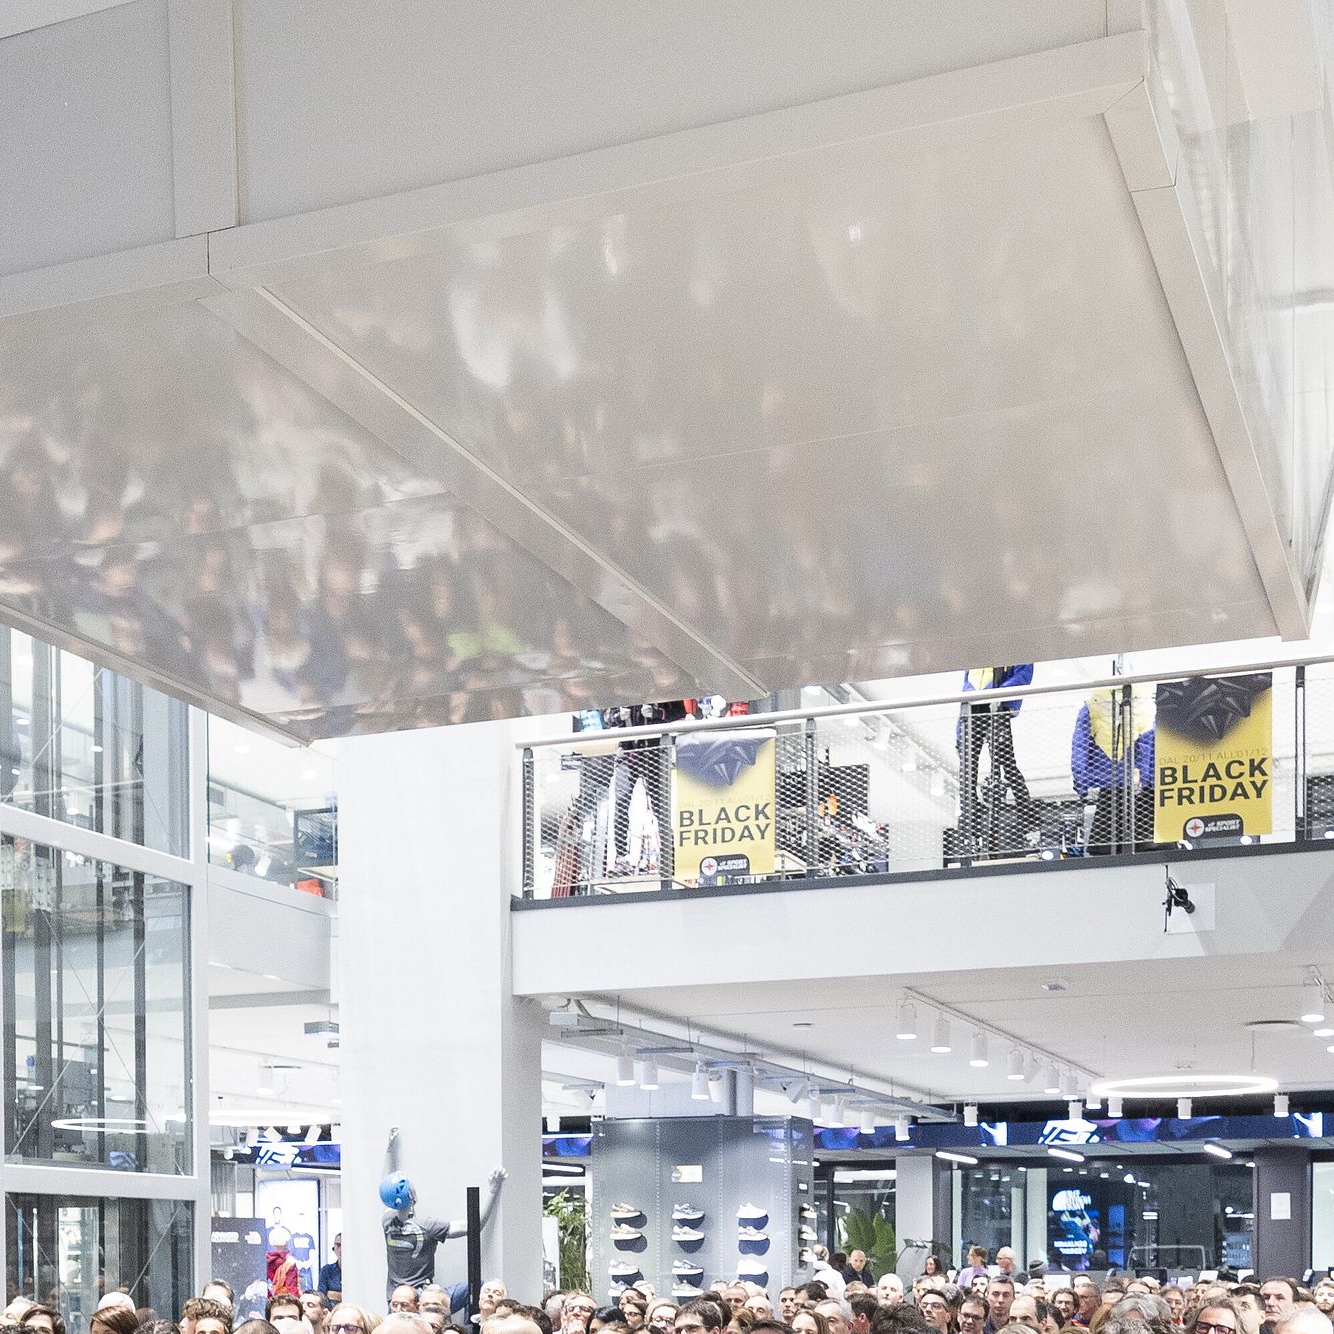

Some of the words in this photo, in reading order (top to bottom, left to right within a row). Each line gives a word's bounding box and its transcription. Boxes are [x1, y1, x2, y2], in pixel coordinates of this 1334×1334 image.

[1159, 757, 1269, 786] BLACK
[1159, 779, 1269, 807] FRIDAY
[679, 802, 771, 828] BLACK
[679, 823, 771, 847] FRIDAY
